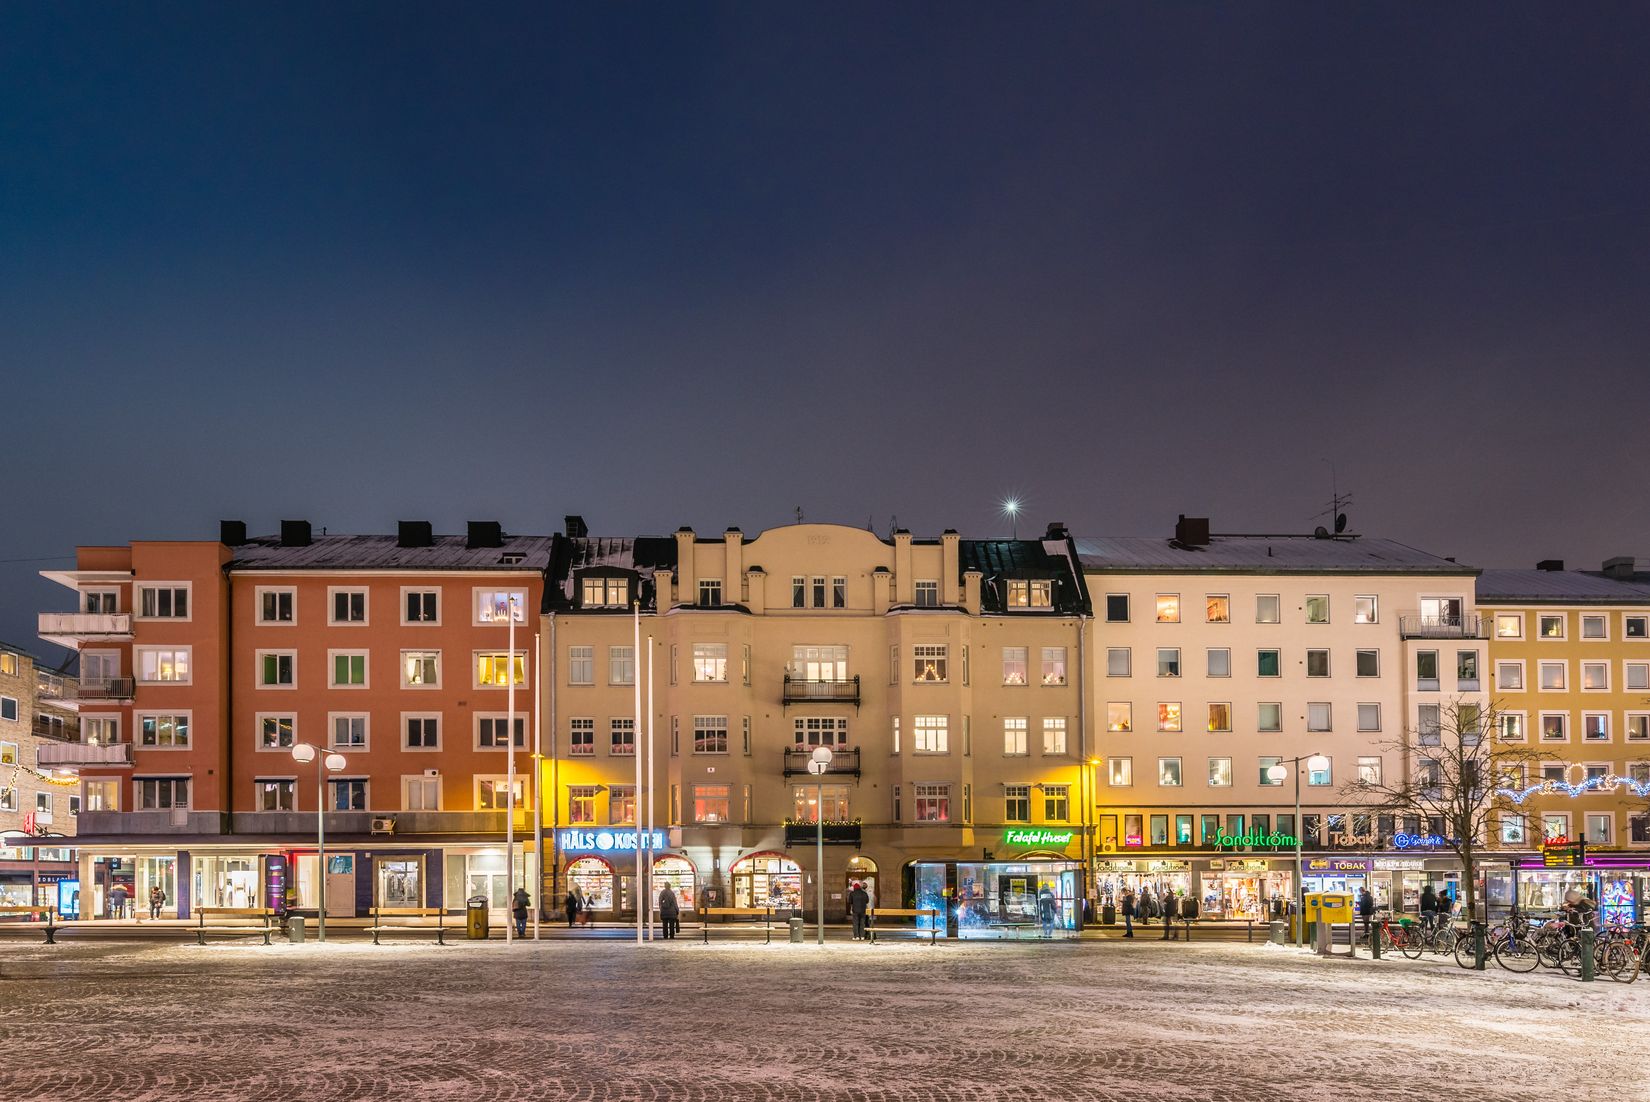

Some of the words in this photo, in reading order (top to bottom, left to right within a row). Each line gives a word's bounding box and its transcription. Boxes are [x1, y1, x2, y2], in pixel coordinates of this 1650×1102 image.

[1006, 831, 1041, 845] Falafel
[1041, 832, 1073, 844] Huset
[1334, 861, 1366, 870] TOBAK
